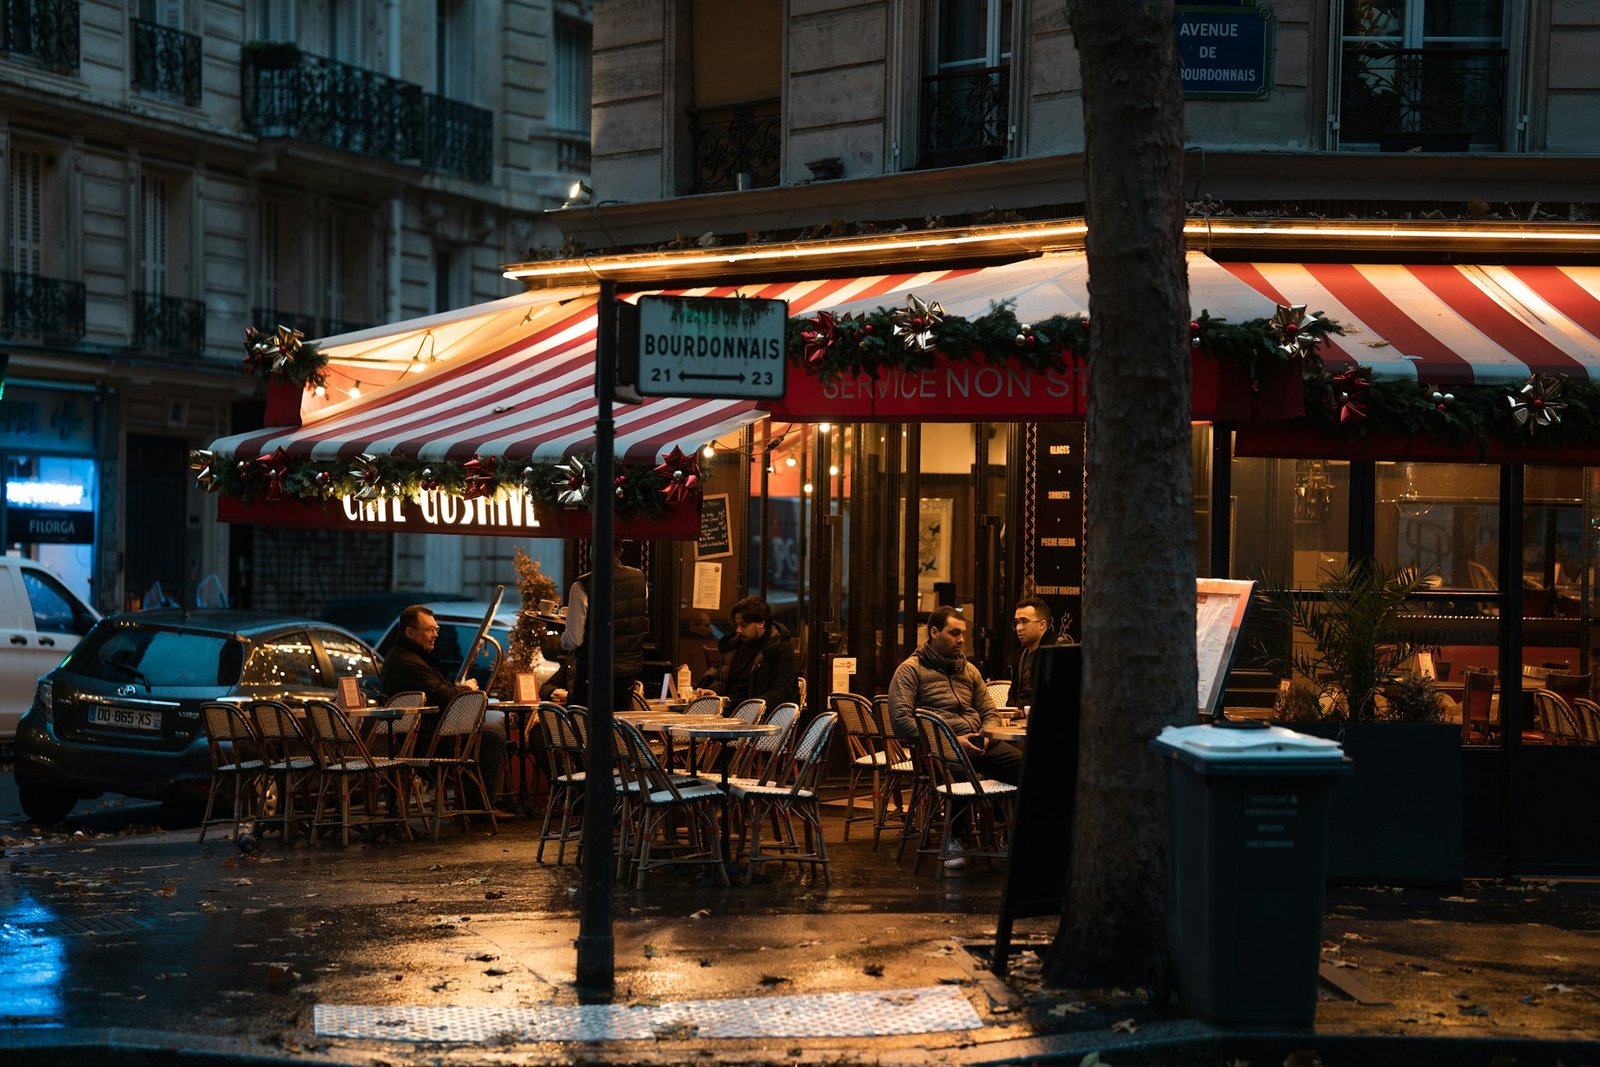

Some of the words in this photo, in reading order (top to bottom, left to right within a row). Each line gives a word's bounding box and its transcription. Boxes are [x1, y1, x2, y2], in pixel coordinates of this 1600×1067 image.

[1180, 23, 1238, 36] AVENUE
[1199, 46, 1217, 58] DE
[645, 334, 780, 360] BOURDONNAIS
[651, 368, 671, 382] 21
[751, 371, 774, 386] 23
[823, 366, 937, 399] SERVICE
[946, 366, 1031, 398] NON
[1046, 367, 1088, 398] ST
[1048, 491, 1070, 500] SORBETS
[29, 519, 76, 536] FILORGA
